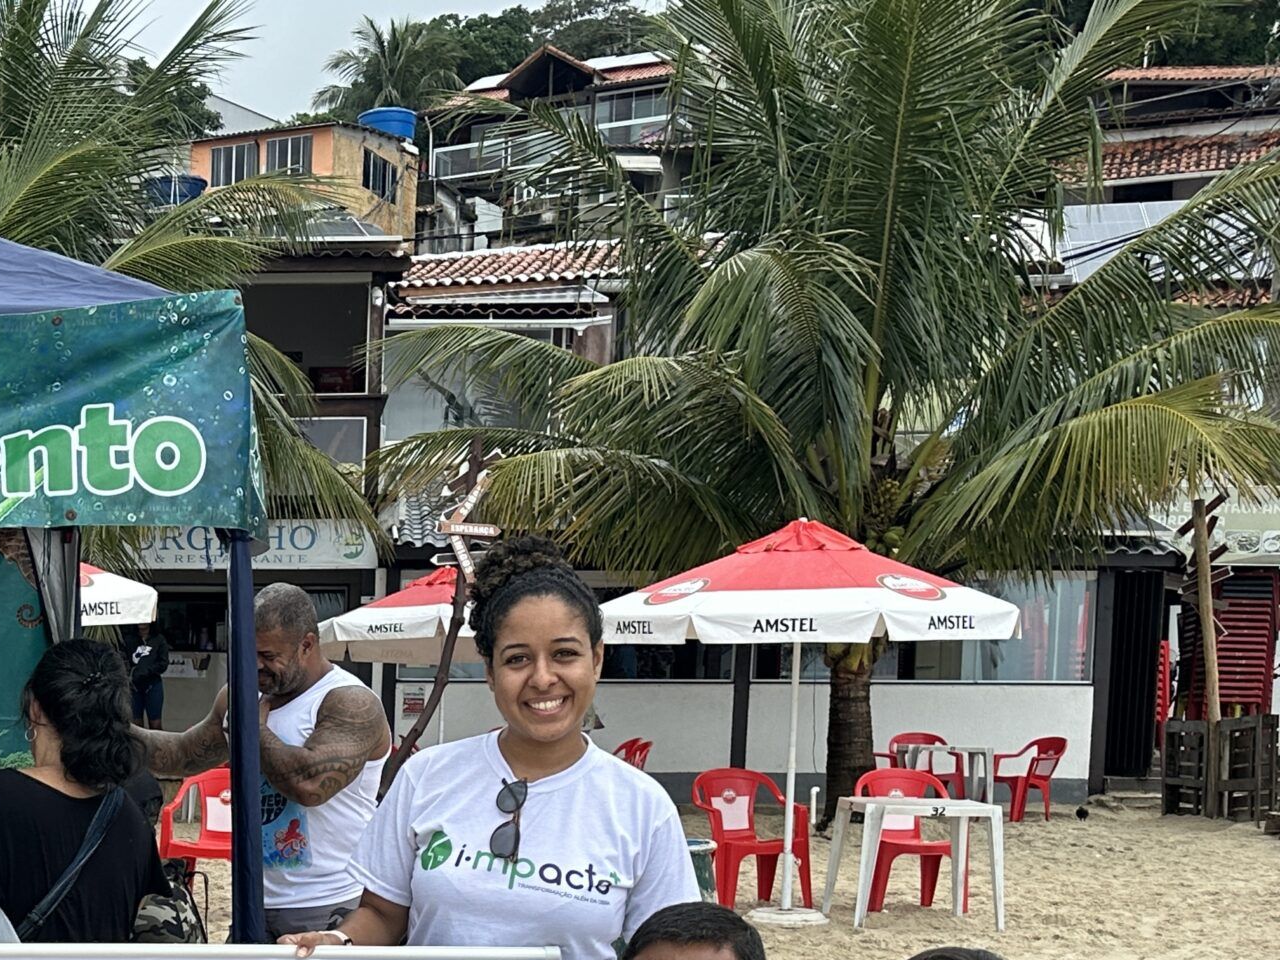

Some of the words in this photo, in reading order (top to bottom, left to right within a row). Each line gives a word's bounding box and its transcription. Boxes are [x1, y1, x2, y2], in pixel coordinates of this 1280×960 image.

[450, 524, 494, 536] ESPERANÇA
[174, 553, 308, 564] RESTARANTE
[81, 601, 121, 616] AMSTEL
[367, 622, 404, 634] AMSTEL
[616, 620, 653, 635] AMSTEL
[752, 617, 817, 634] AMSTEL
[928, 615, 975, 630] AMSTEL
[931, 806, 946, 817] 32
